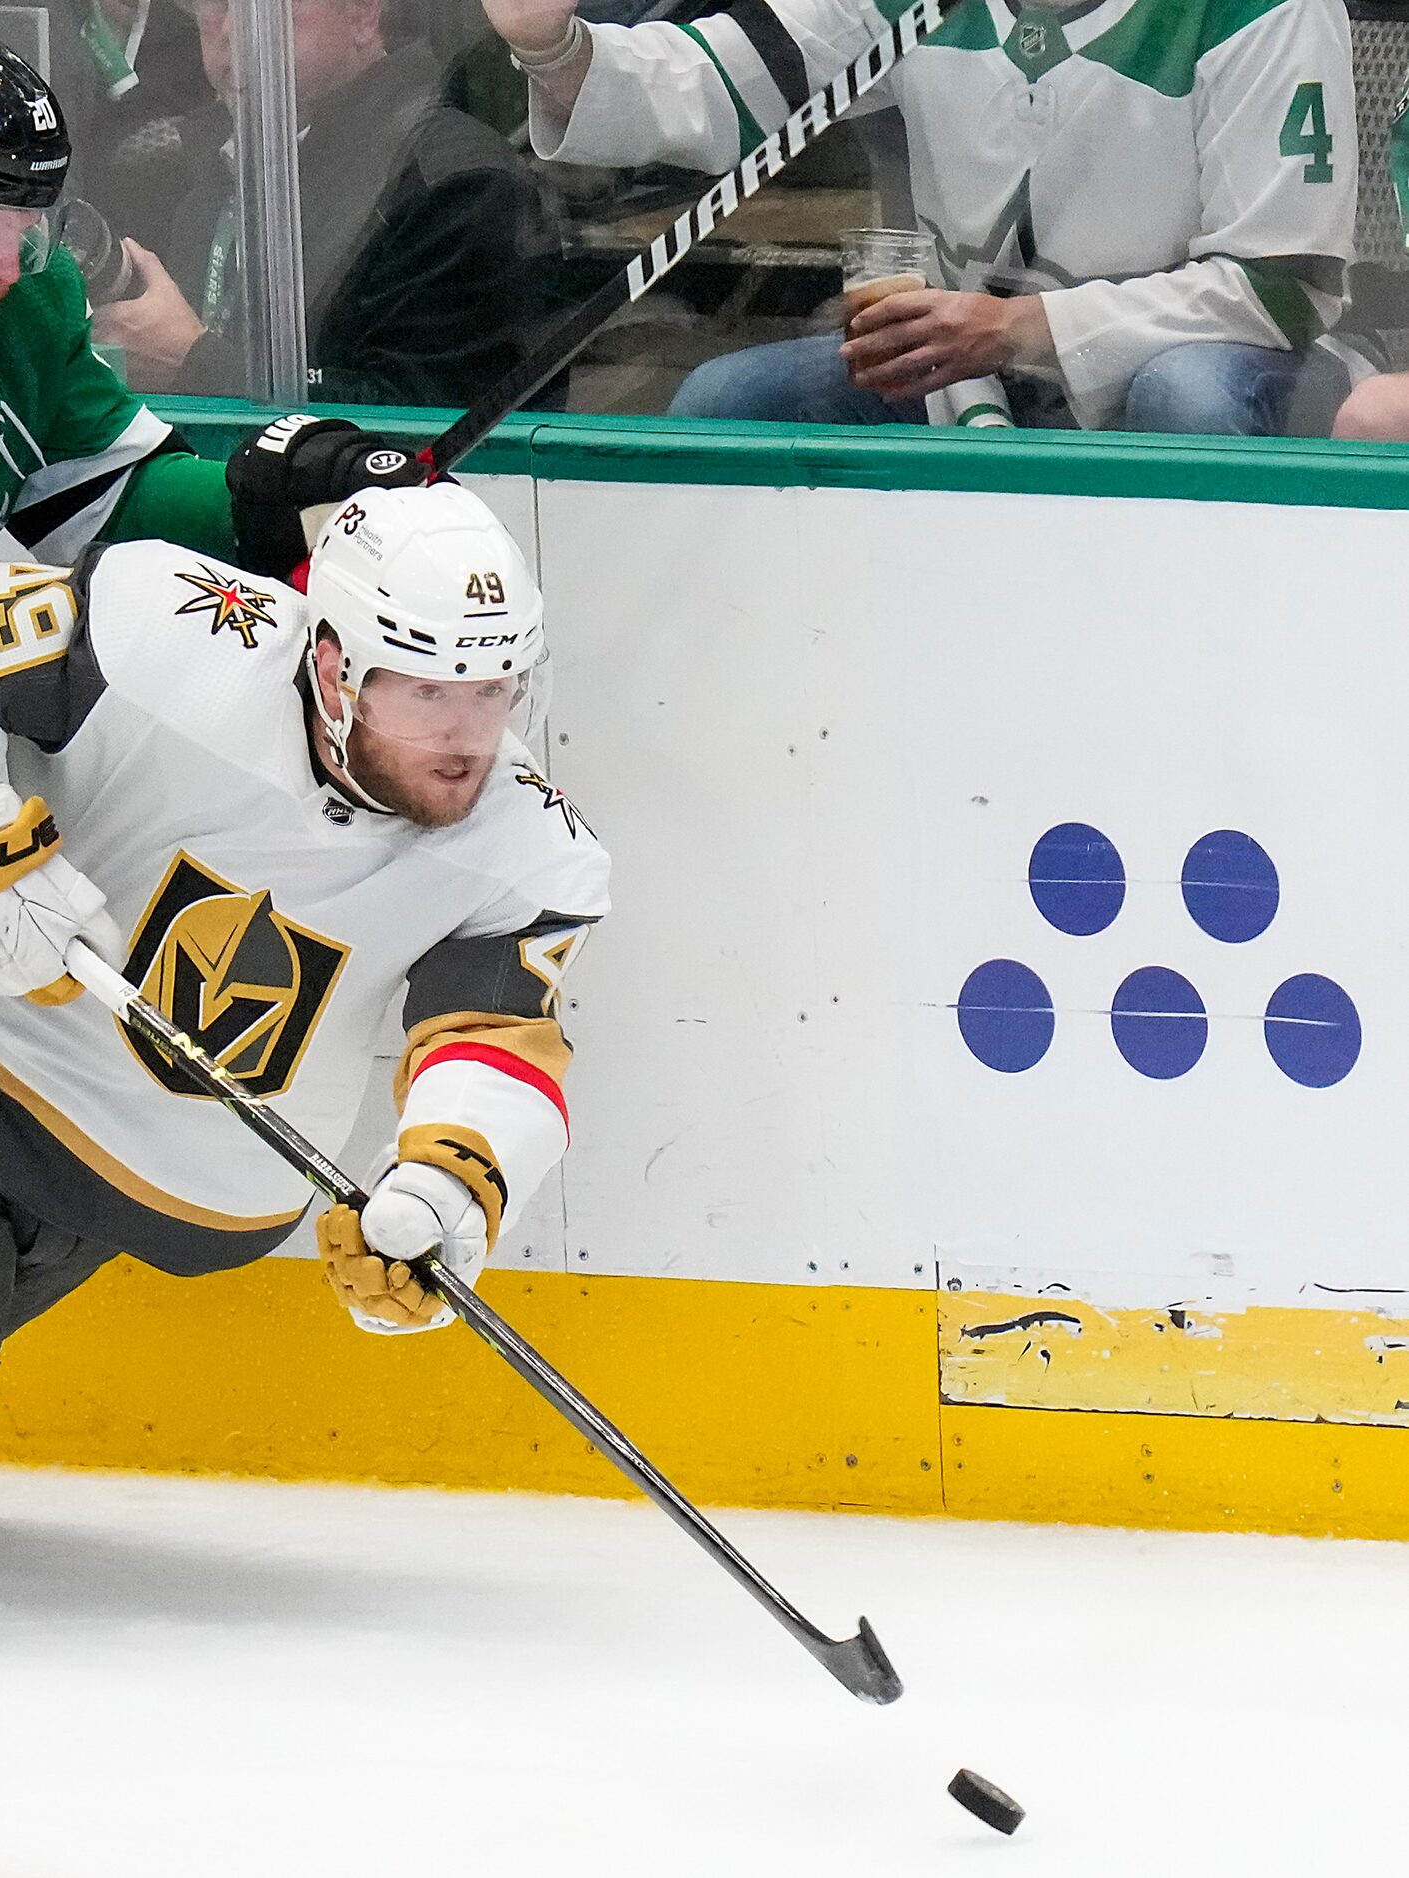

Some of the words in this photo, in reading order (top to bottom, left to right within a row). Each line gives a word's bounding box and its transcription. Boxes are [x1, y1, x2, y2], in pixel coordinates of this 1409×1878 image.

[24, 97, 58, 131] 20
[1278, 82, 1334, 184] 4
[625, 0, 944, 302] WARRIOR
[334, 502, 367, 536] P3
[360, 524, 384, 547] Health
[354, 531, 384, 562] Partners
[465, 572, 507, 605] 49
[454, 632, 519, 649] CCM
